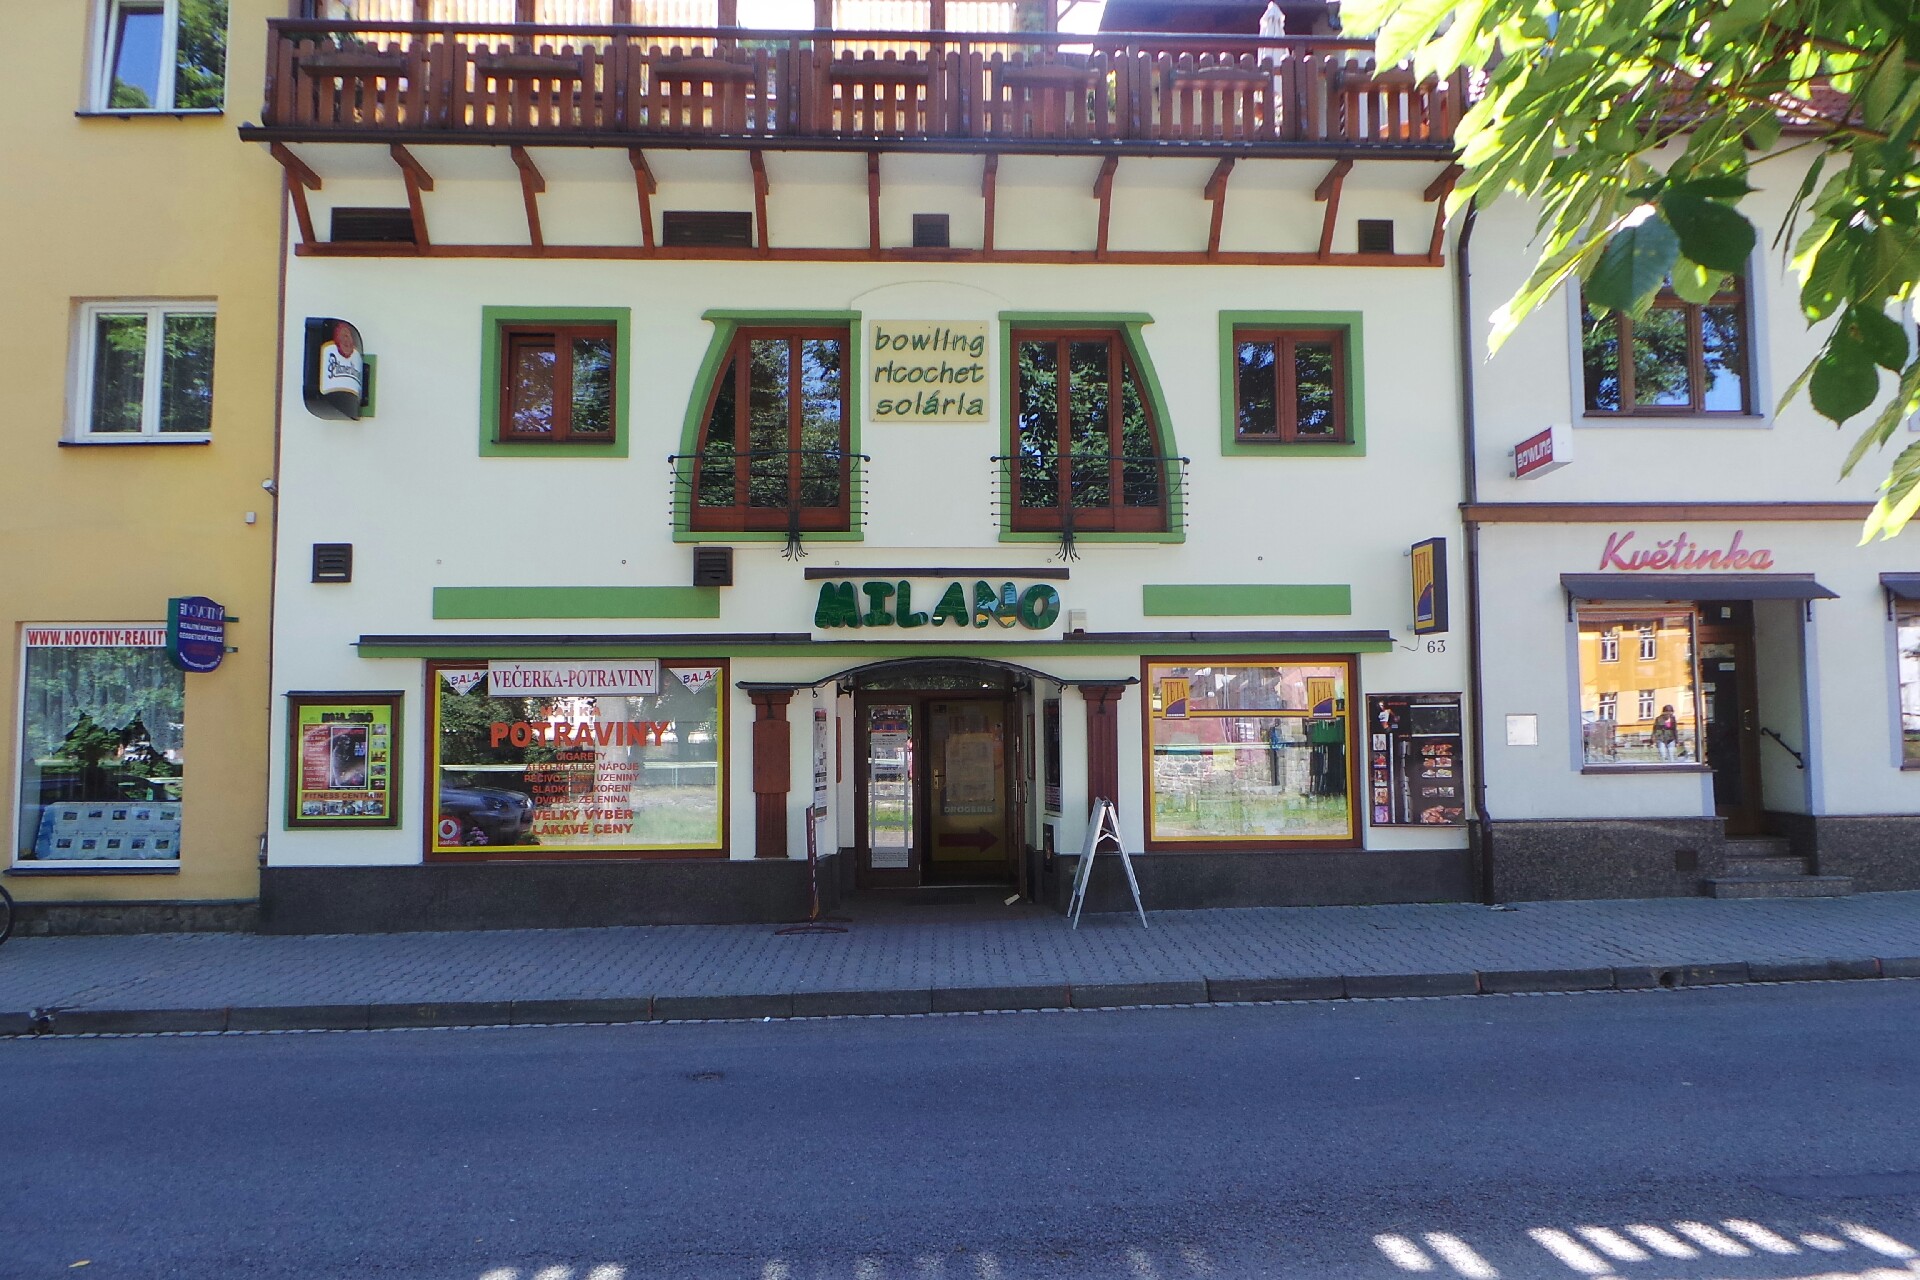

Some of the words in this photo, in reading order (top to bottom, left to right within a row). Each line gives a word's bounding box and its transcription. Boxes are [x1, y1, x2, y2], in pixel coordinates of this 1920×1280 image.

[875, 327, 984, 358] bowling
[875, 360, 984, 384] ricochet
[876, 390, 983, 415] solária
[1517, 437, 1552, 468] BOWLING
[1599, 530, 1773, 570] Květinka
[814, 580, 1061, 630] MILANO
[1427, 640, 1446, 653] 63
[450, 671, 480, 686] BALA
[492, 664, 654, 688] VEČERKA-POTRAVINY
[683, 670, 713, 684] BALA
[1164, 681, 1186, 706] TETA
[1311, 681, 1333, 706] TETA
[490, 721, 669, 748] POTRAVINY
[556, 752, 607, 761] CIGARETY
[598, 761, 639, 771] NÁPOJE
[596, 773, 640, 782] UZENINY
[593, 782, 632, 793] KOŘENÍ
[579, 794, 628, 804] ZELENINA
[533, 807, 580, 821] VELKÝ
[585, 807, 634, 820] VÝBĚR
[532, 821, 589, 835] LÁKAVÉ
[593, 823, 634, 835] CENY
